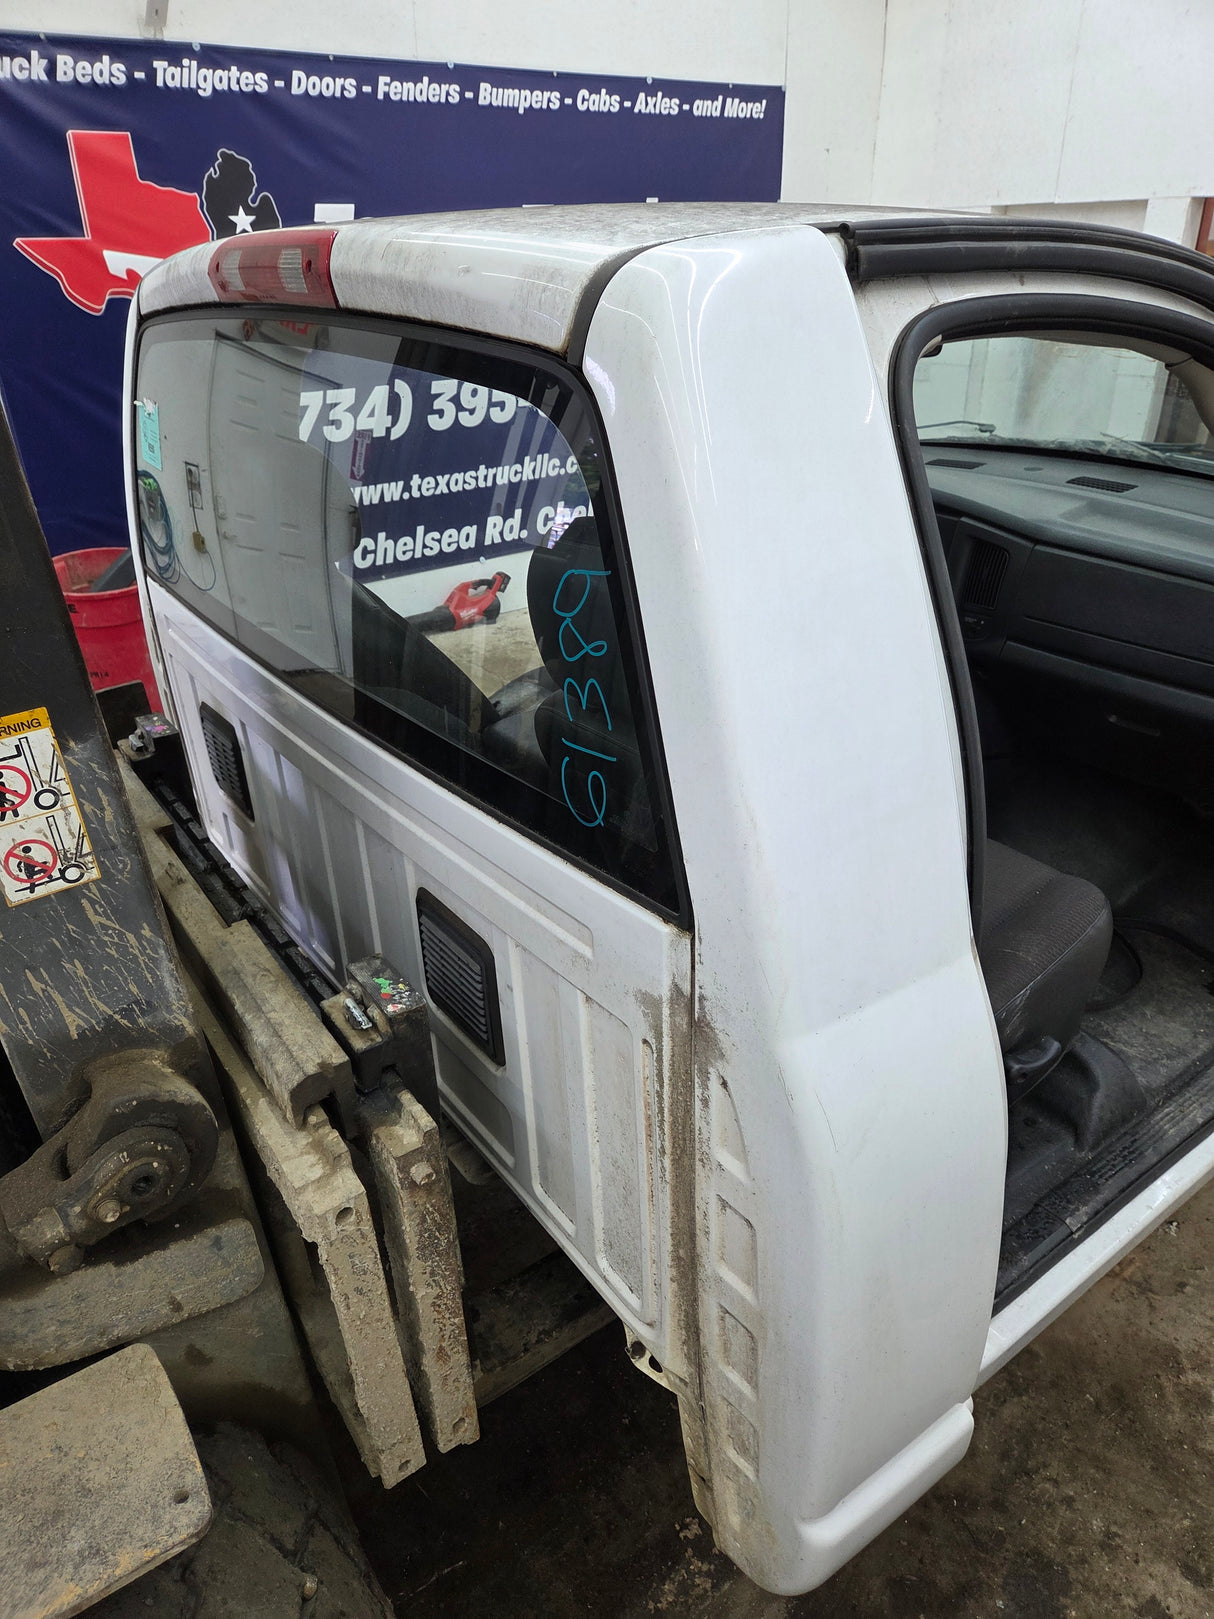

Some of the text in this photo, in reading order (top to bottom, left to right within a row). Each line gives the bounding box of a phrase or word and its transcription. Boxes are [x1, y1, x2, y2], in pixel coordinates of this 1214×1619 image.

[57, 55, 126, 85] Beds
[153, 58, 269, 96] Tailgates
[291, 70, 357, 98] Doors
[377, 76, 460, 103] Fenders
[478, 82, 560, 114] Bumpers
[577, 88, 620, 112] Cabs
[634, 91, 680, 115] Axles
[693, 95, 723, 117] and
[724, 98, 766, 119] More!
[353, 525, 477, 569] Chelsea
[484, 508, 528, 546] Rd.
[553, 569, 616, 827] 61389
